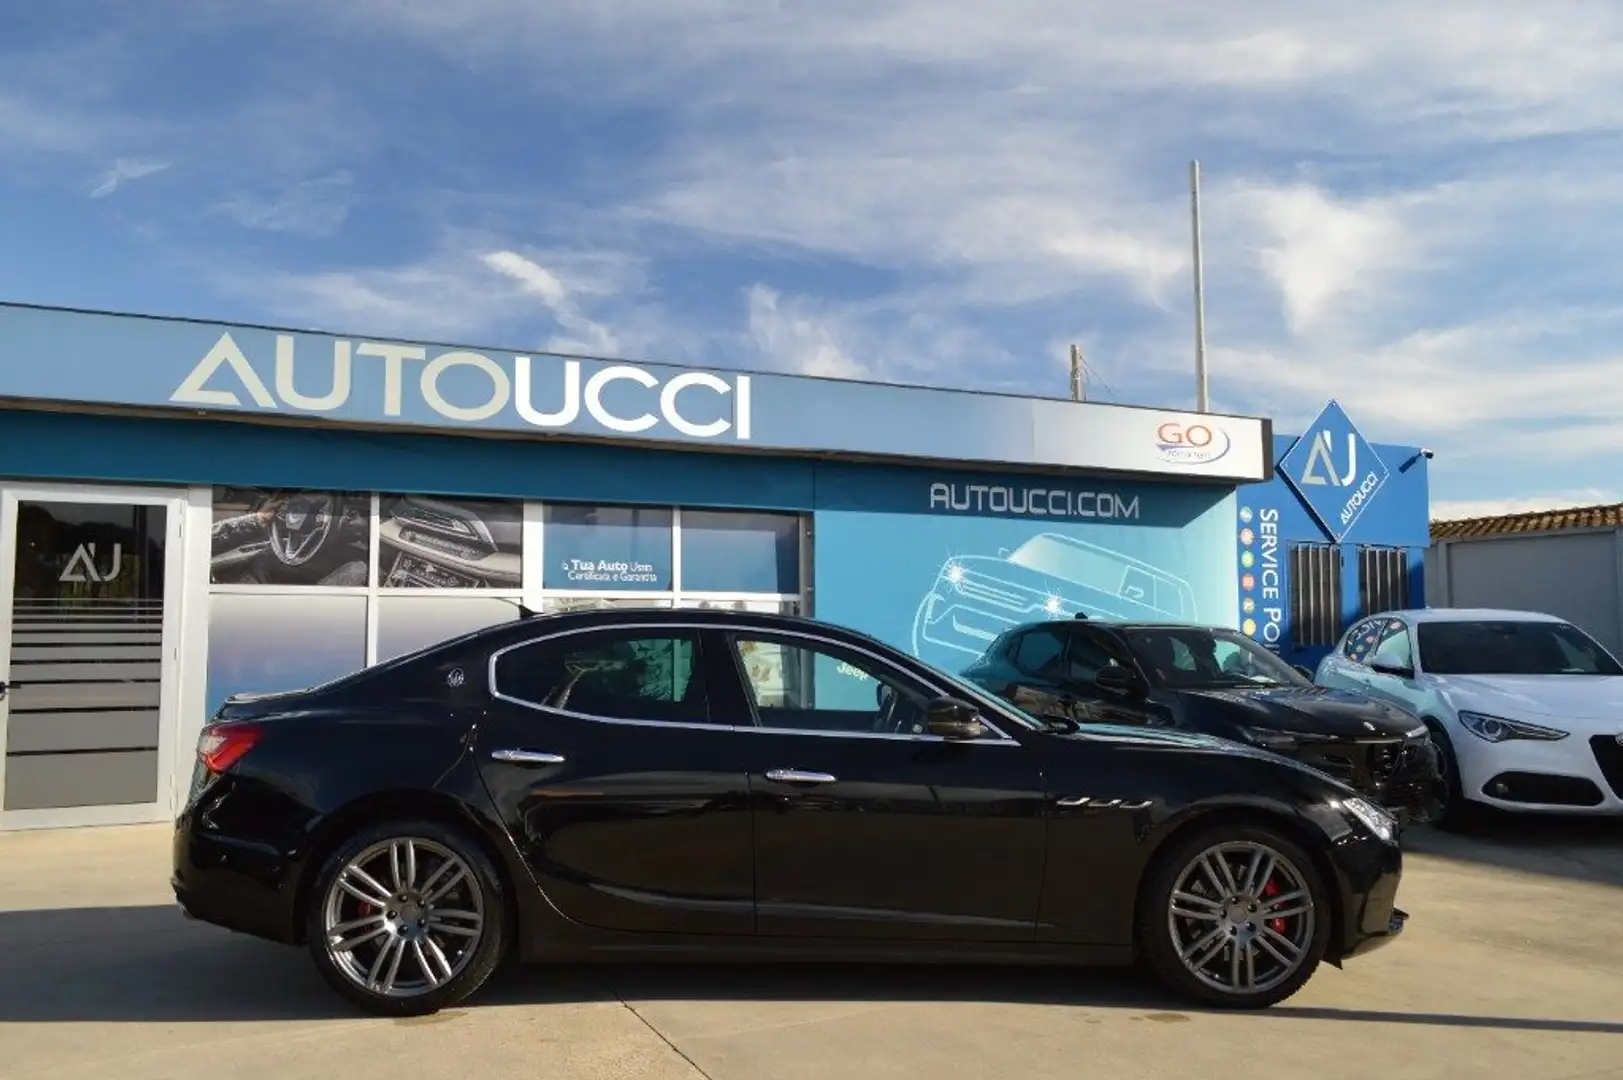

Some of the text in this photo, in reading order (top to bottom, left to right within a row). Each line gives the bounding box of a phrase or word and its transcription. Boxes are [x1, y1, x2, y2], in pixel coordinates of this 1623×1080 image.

[168, 331, 751, 440] AUTOUCCI
[1157, 422, 1212, 447] GO
[930, 482, 1140, 519] AUTOUCCI.COM
[1340, 471, 1379, 525] AUTOUCCI
[570, 559, 595, 571] Tua
[597, 560, 628, 572] Auto
[1260, 508, 1280, 600] SERVICE
